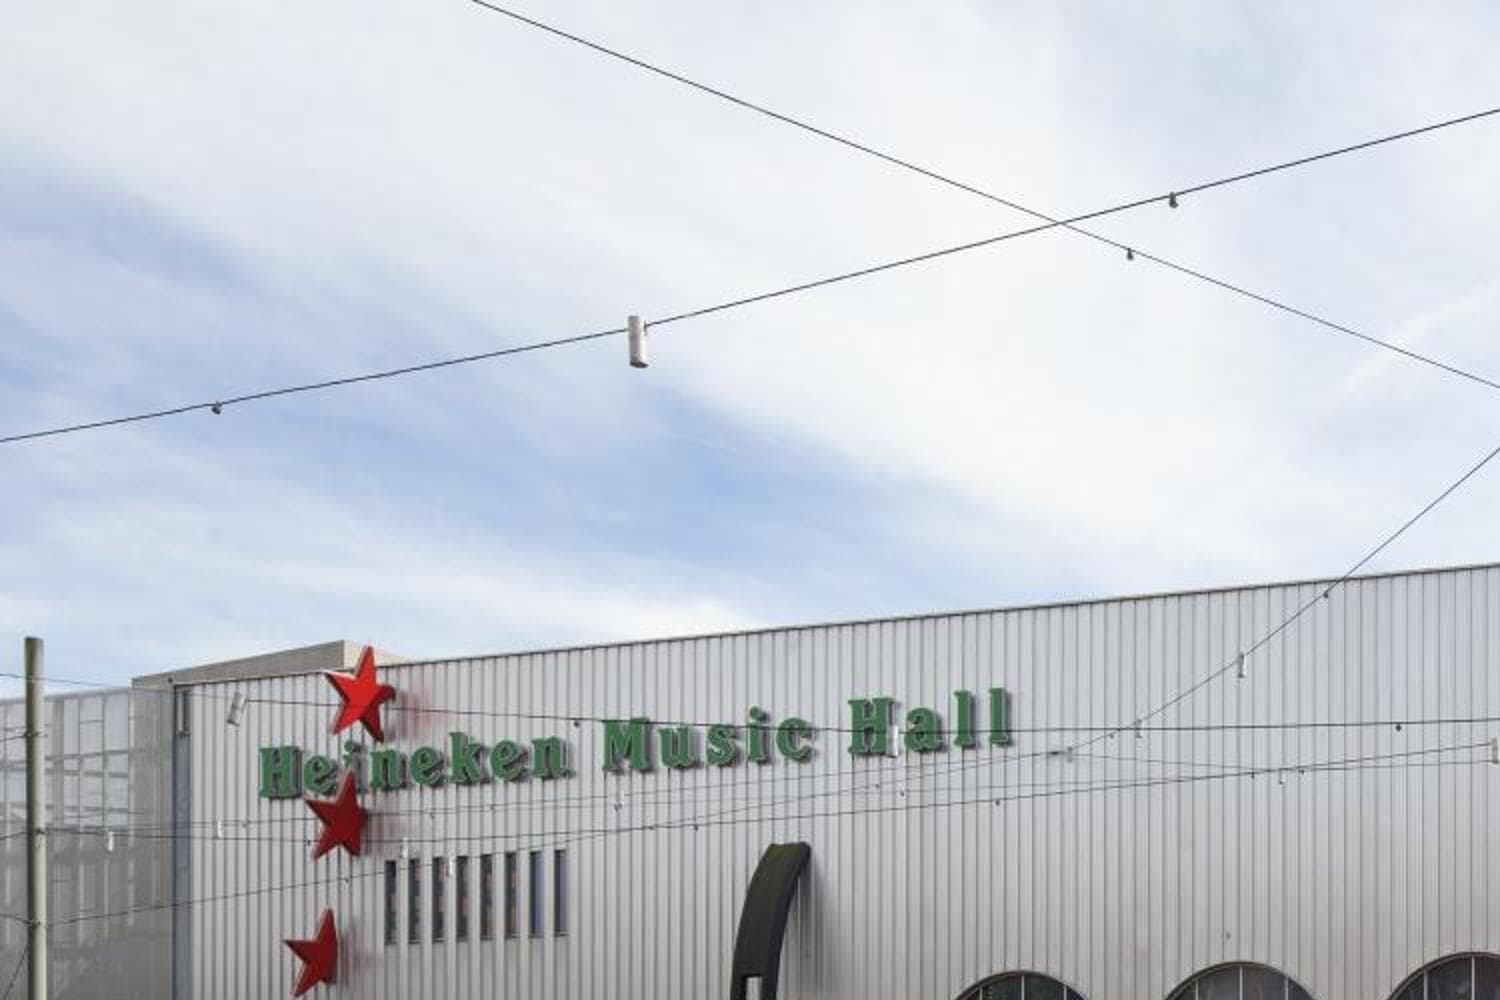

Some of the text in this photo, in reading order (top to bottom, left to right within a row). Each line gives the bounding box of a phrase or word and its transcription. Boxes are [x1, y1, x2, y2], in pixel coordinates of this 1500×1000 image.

[258, 688, 1011, 799] Heineken Music Hall
